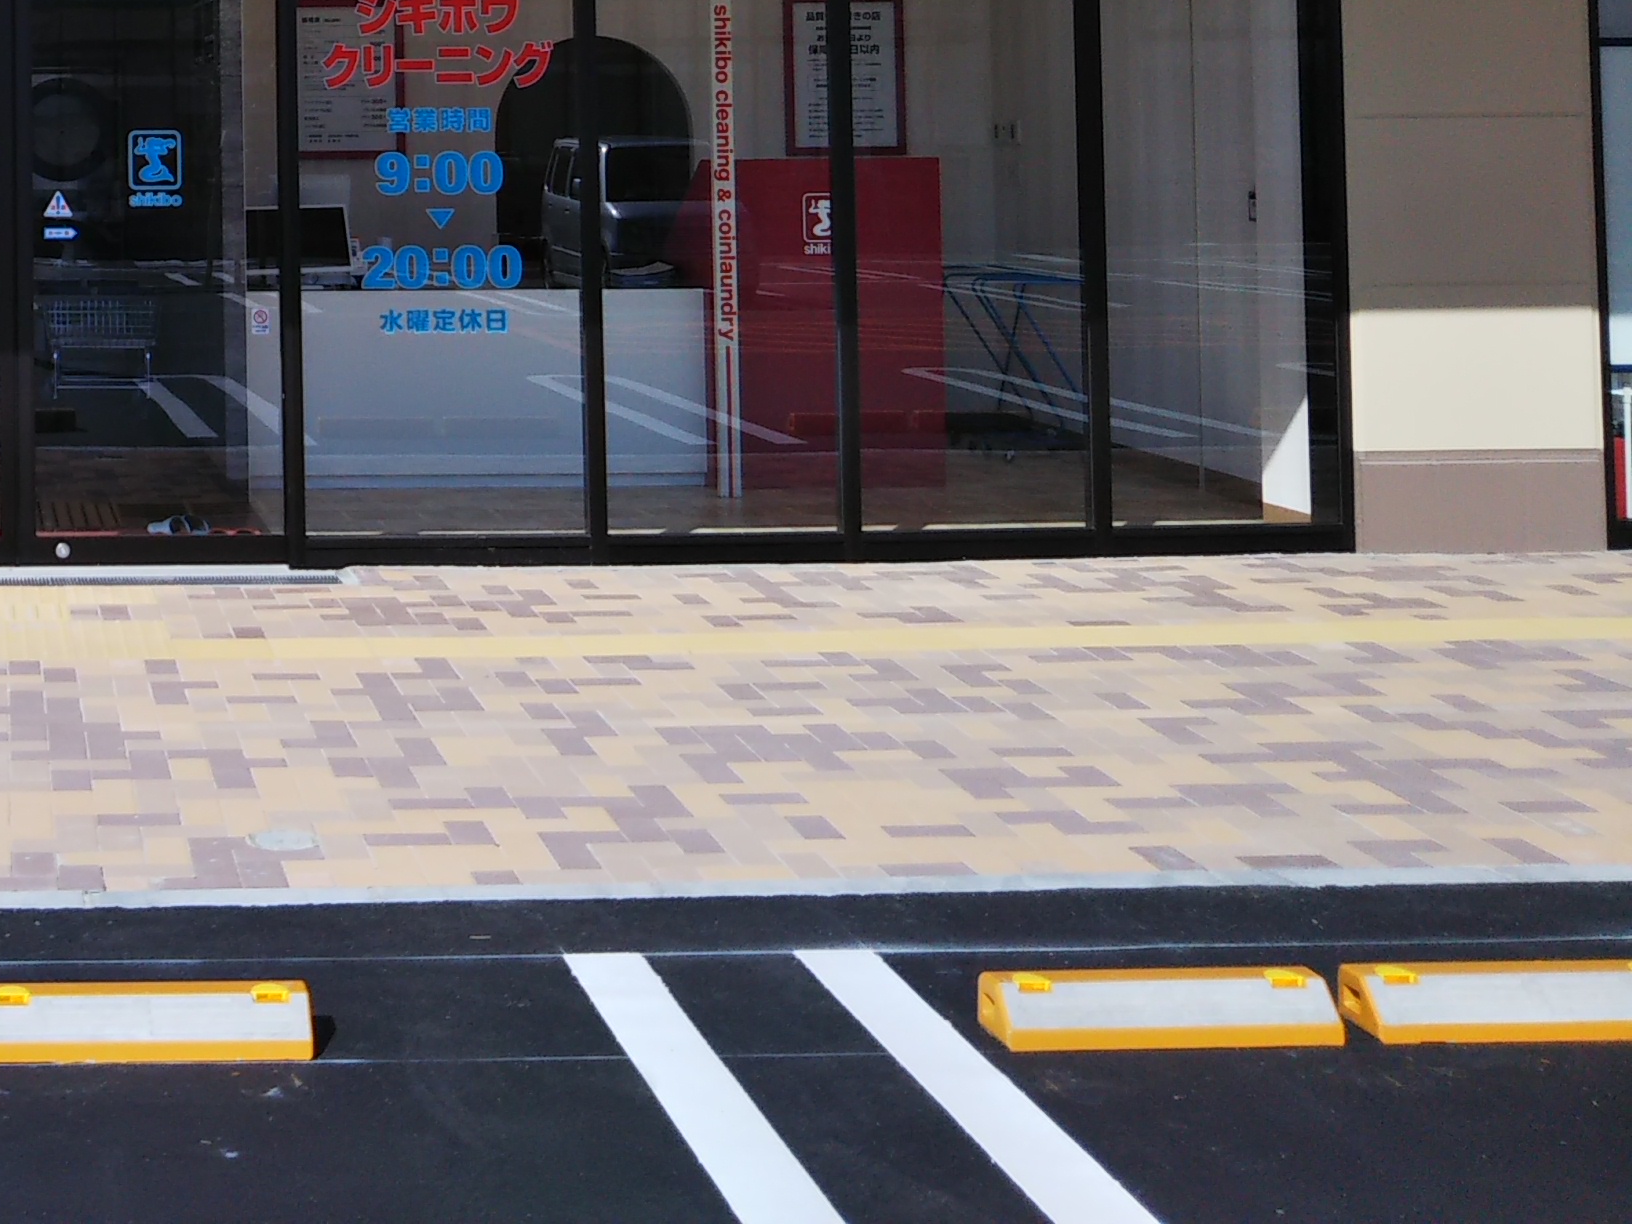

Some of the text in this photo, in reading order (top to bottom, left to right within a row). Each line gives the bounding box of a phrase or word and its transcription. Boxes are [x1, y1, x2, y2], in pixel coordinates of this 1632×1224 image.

[322, 40, 556, 90] クリーニング
[385, 106, 493, 133] 営業時間
[374, 150, 504, 196] 9:00
[714, 4, 737, 341] shikibo cleaning & coinlaundry
[128, 192, 183, 208] shikibo
[361, 244, 523, 290] 20:00
[803, 243, 832, 255] shiki
[379, 309, 510, 335] 水曜定休日
